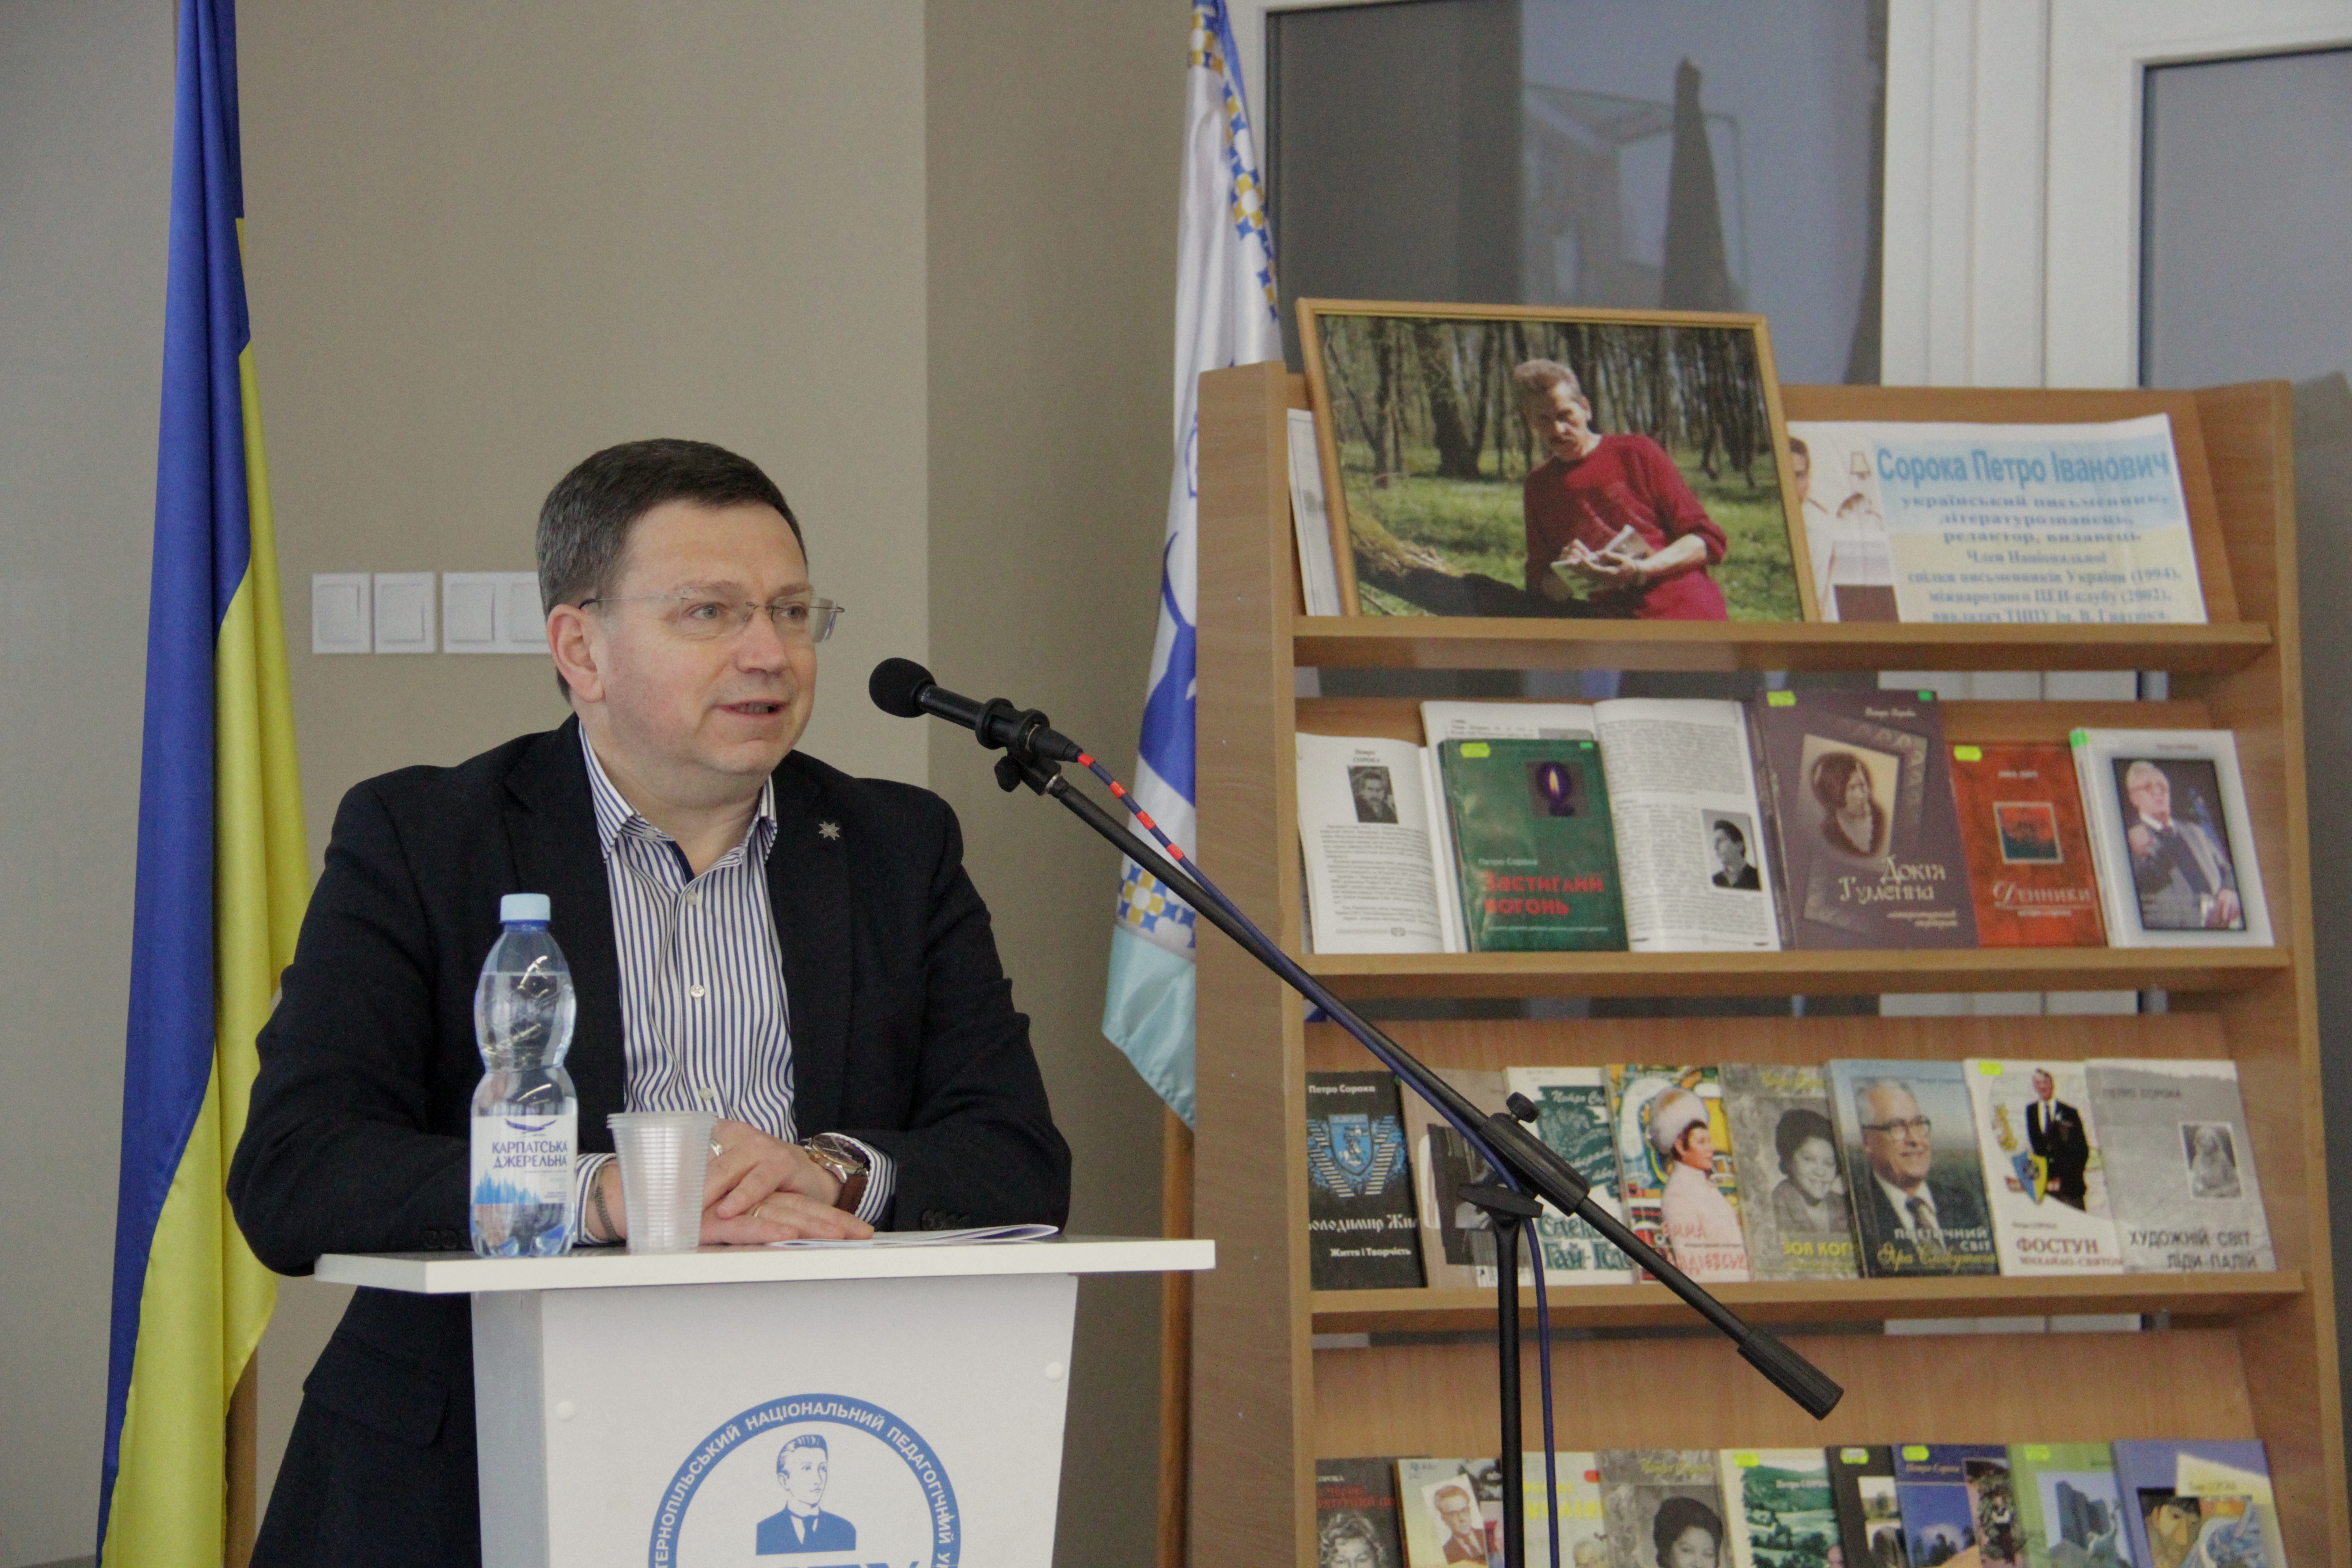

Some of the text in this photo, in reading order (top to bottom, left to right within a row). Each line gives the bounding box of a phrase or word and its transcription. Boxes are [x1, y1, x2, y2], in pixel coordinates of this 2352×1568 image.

[1877, 447, 2169, 490] Сорока Петро Іванович
[1308, 1084, 1376, 1095] Петро Сорока
[492, 1141, 567, 1154] КАРПАТСЬКА
[493, 1155, 567, 1169] ДЖЕРЕЛЬНА
[1960, 1240, 1991, 1251] СВІТ
[2016, 1237, 2099, 1254] ФОСТУН
[2128, 1228, 2249, 1248] ХУДОЖНІЙ СВІТ
[655, 1423, 741, 1568] ТЕРНОПІЛЬСЬКИЙ
[745, 1401, 886, 1431] НАЦІОНАЛЬНИЙ
[886, 1426, 956, 1544] ПЕДАГОГІЧНИЙ
